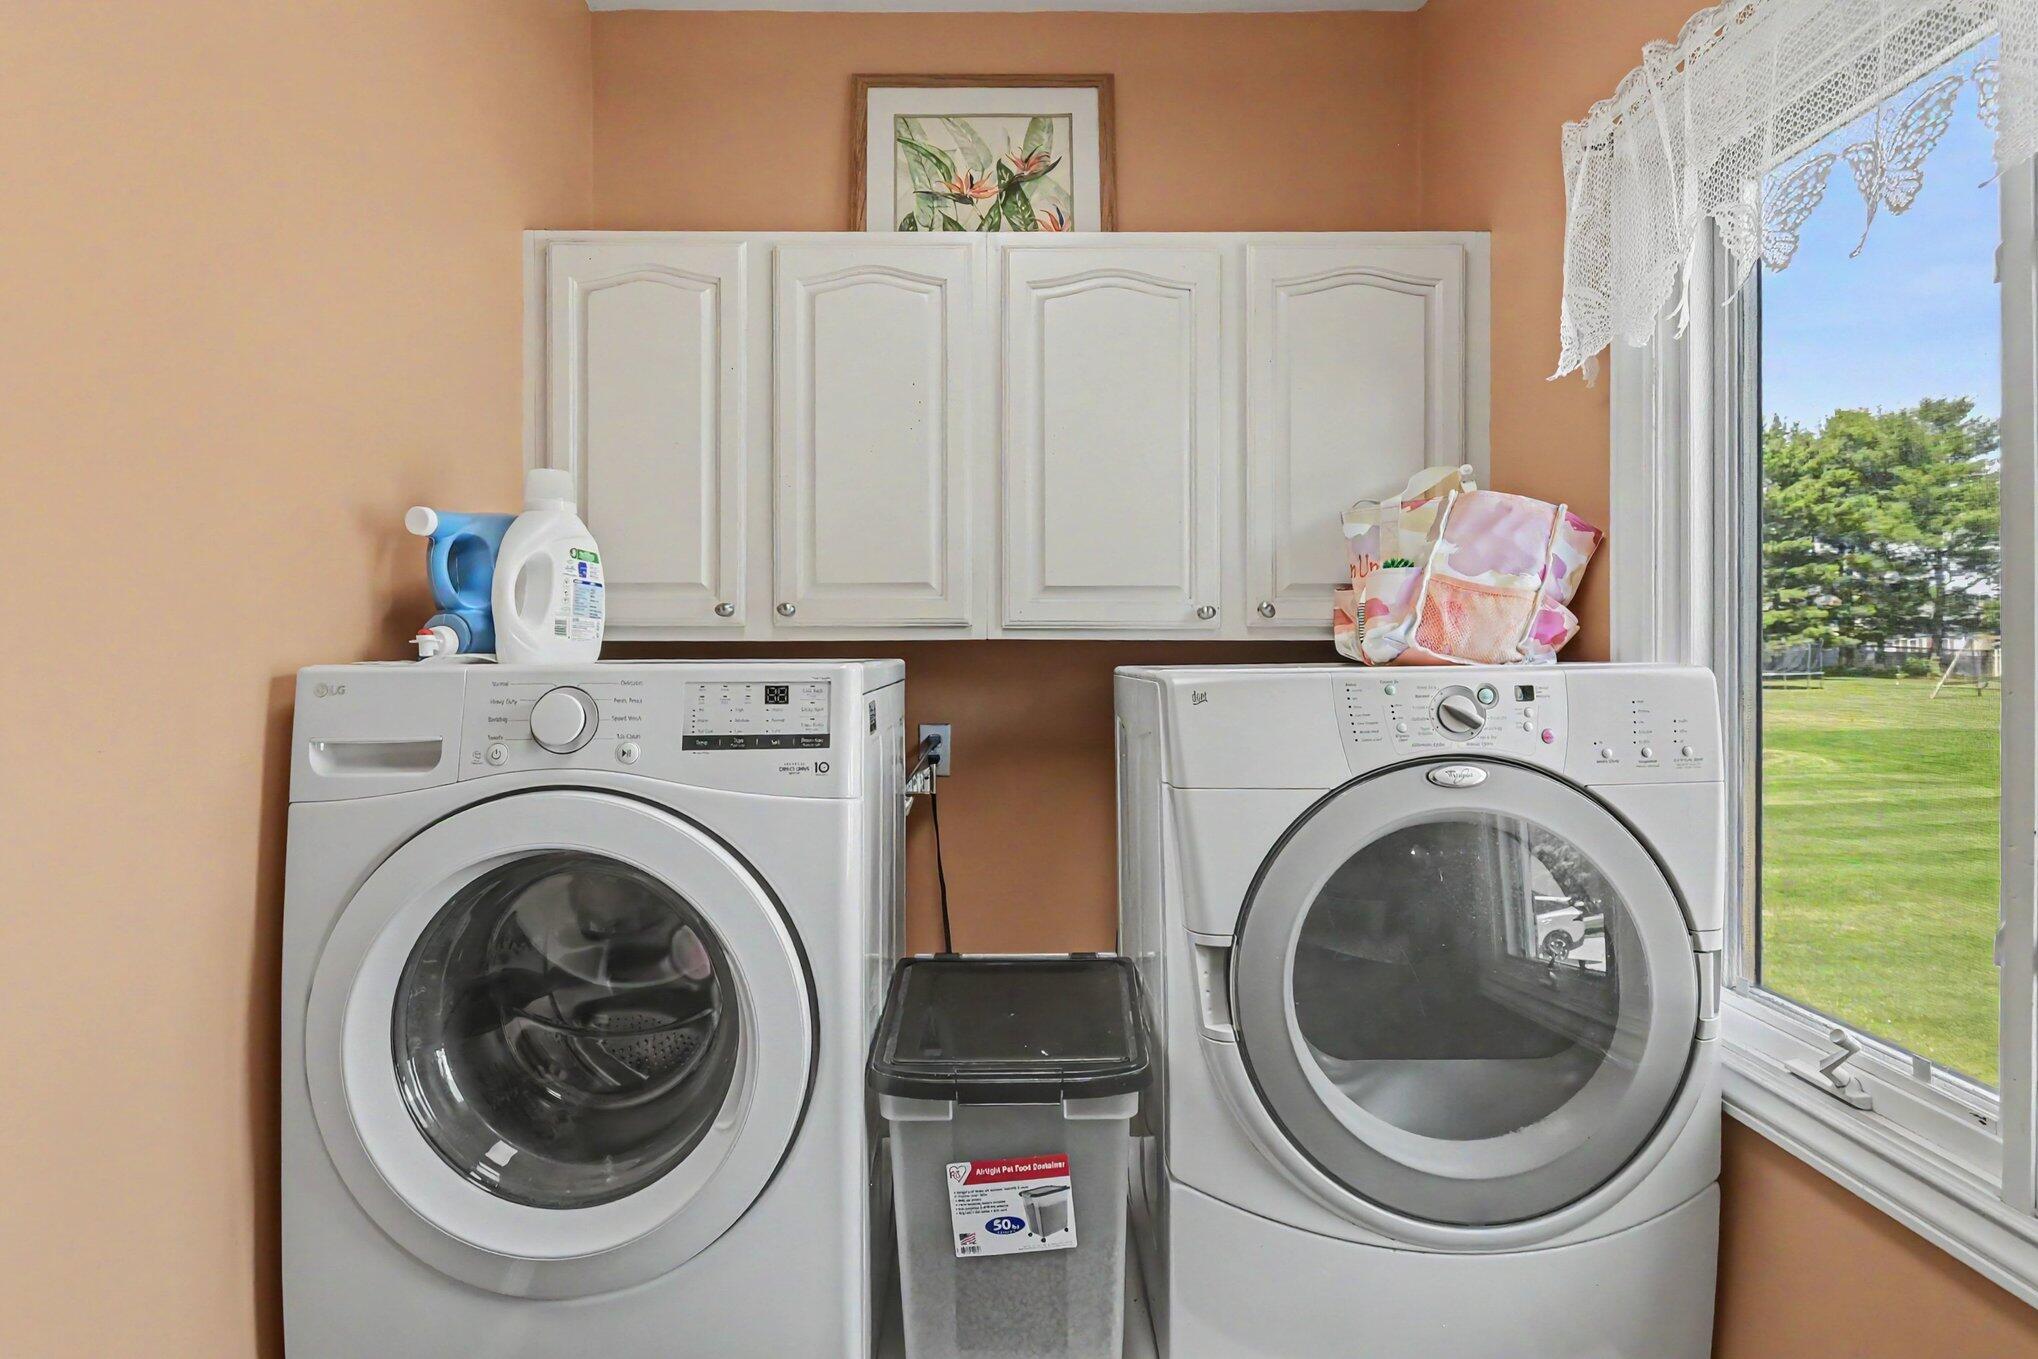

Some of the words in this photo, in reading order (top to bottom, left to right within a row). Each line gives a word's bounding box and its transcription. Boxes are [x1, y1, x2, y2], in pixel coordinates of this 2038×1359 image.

[1002, 1164, 1014, 1173] Pet
[1014, 1163, 1031, 1173] Food
[1033, 1161, 1065, 1172] Container
[993, 1219, 1012, 1231] 50
